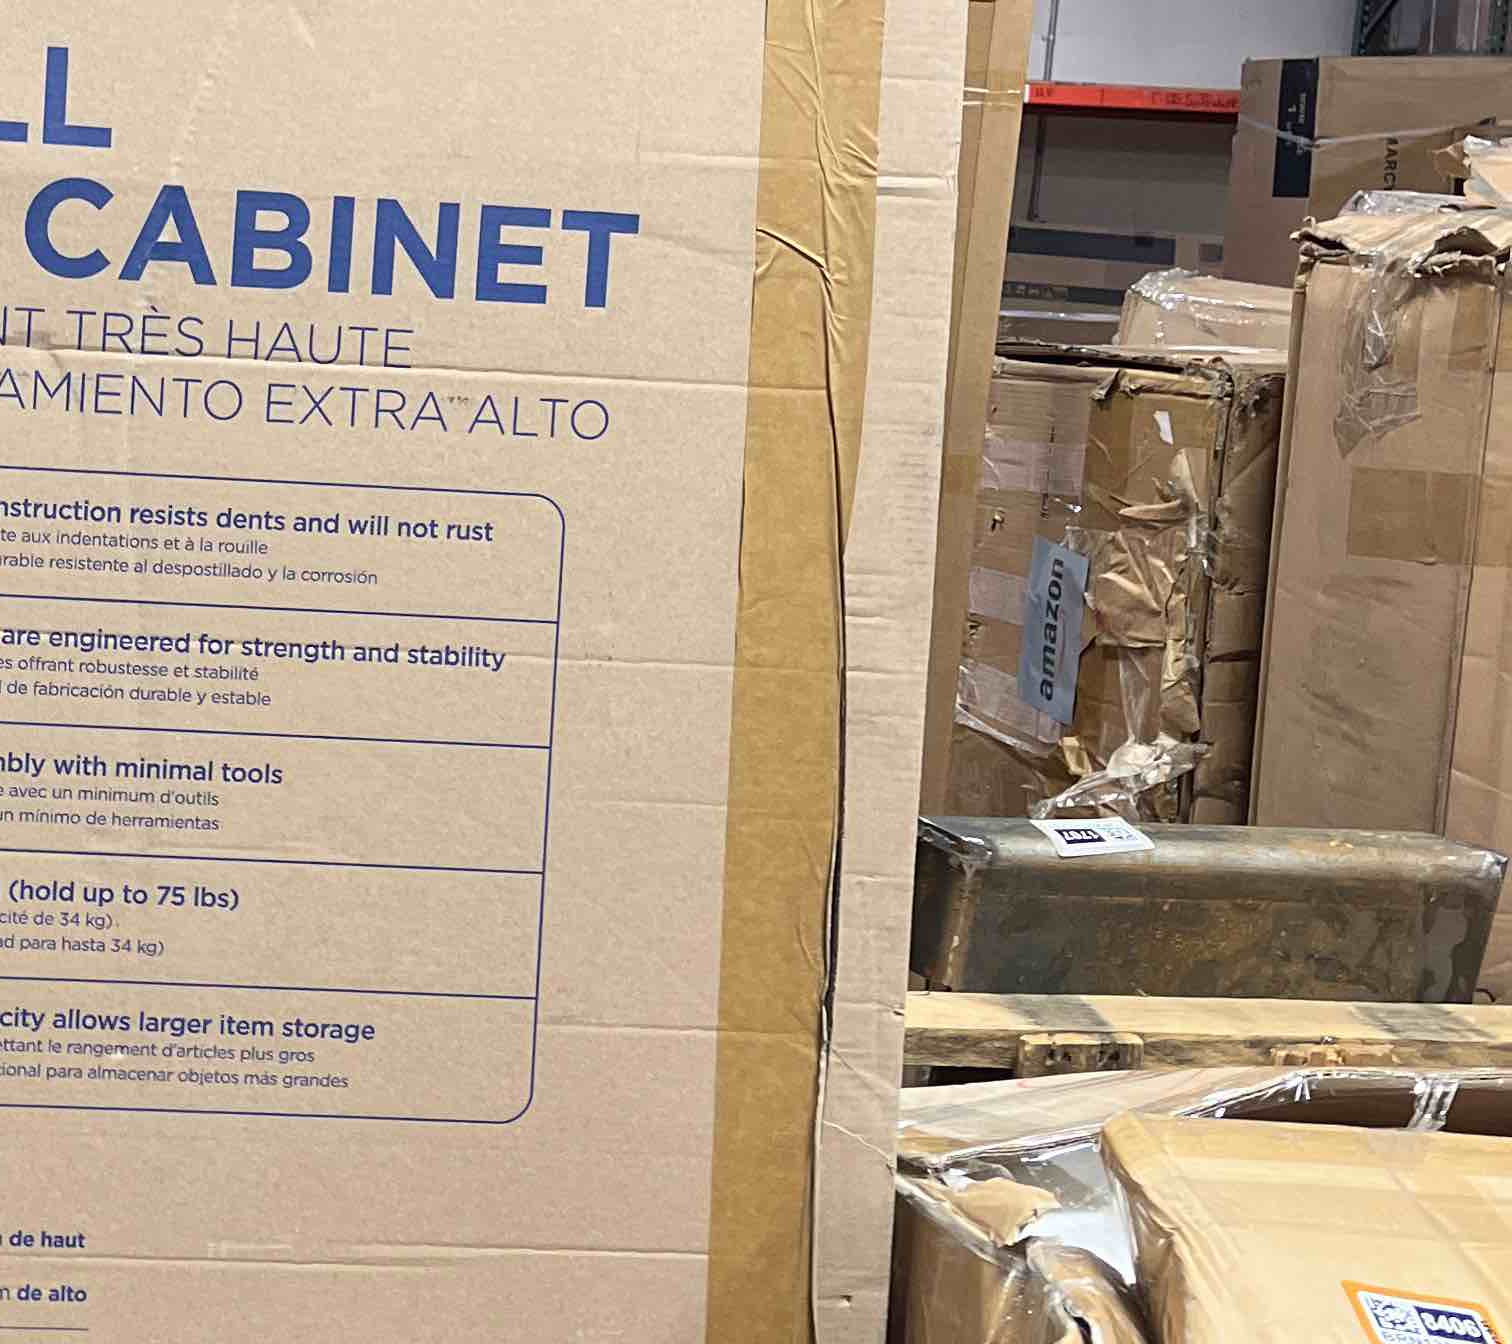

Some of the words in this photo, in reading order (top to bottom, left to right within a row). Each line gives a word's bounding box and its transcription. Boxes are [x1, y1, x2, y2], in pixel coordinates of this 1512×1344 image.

[1384, 137, 1400, 189] ARC
[25, 178, 640, 312] CABINET
[68, 306, 207, 357] TRÈS
[227, 320, 415, 368] HAUTE
[266, 384, 447, 432] EXTRA
[468, 395, 608, 440] ALTO
[22, 532, 50, 543] aux
[57, 531, 158, 549] indentations
[164, 537, 180, 550] et
[185, 537, 194, 551] à
[200, 537, 212, 551] la
[219, 540, 268, 554] rouille
[130, 505, 207, 526] resists
[216, 508, 285, 530] dents
[293, 513, 339, 533] and
[348, 515, 388, 535] will
[398, 520, 438, 538] not
[447, 523, 493, 541] rust
[1040, 559, 1065, 702] amazon
[2, 629, 40, 645] are
[47, 629, 190, 653] engineered
[198, 634, 234, 654] for
[241, 638, 344, 663] strength
[354, 643, 399, 663] and
[408, 645, 506, 672] stability
[54, 755, 106, 776] with
[116, 758, 213, 781] minimal
[222, 763, 282, 784] tools
[9, 880, 74, 903] (hold
[84, 887, 114, 907] up
[123, 885, 147, 904] to
[158, 886, 185, 906] 75
[194, 887, 238, 911] lbs)
[53, 1009, 130, 1031] allows
[140, 1011, 212, 1037] larger
[220, 1015, 273, 1036] item
[282, 1019, 375, 1043] storage
[47, 1067, 82, 1080] para
[88, 1065, 174, 1081] almacenar
[178, 1069, 239, 1085] objetos
[244, 1074, 278, 1085] más
[282, 1074, 348, 1088] grandes
